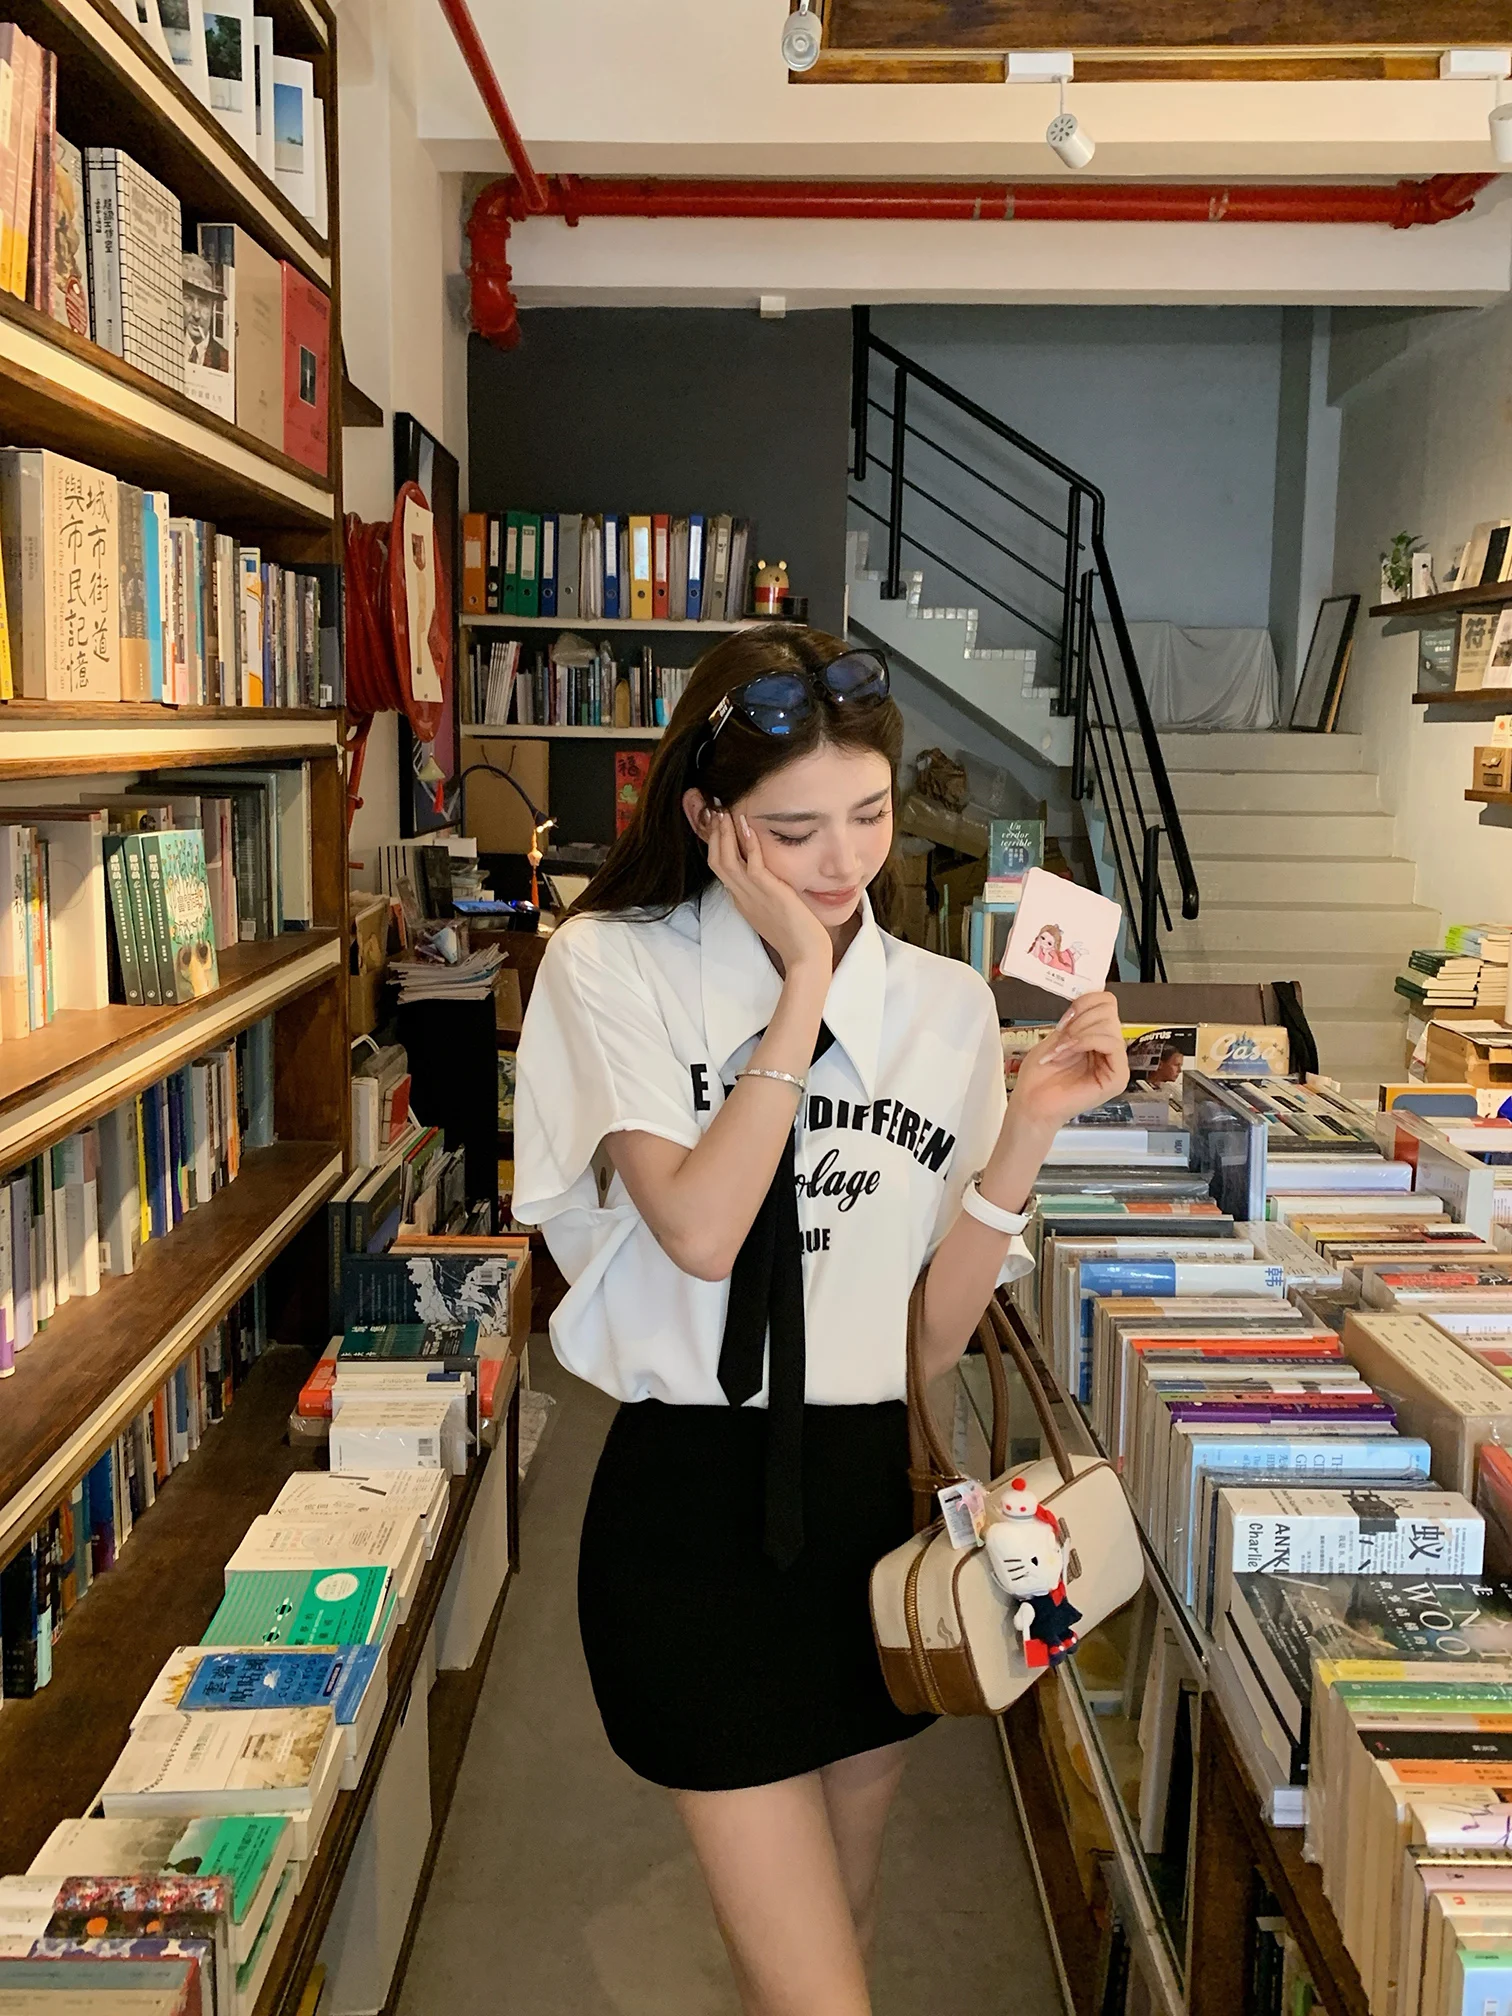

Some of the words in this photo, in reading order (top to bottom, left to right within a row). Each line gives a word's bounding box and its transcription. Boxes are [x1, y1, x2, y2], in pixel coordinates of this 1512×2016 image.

[87, 478, 110, 663] 城市街道
[618, 756, 641, 777] 福
[1001, 831, 1030, 839] verdor
[1009, 822, 1022, 830] Un
[1000, 839, 1032, 847] terrible
[1138, 1030, 1172, 1043] BRUTUS
[1210, 1031, 1279, 1062] Casa
[804, 1094, 956, 1178] DIFFEREN
[1248, 1522, 1264, 1567] Charlie
[1408, 1524, 1445, 1561] 蚁
